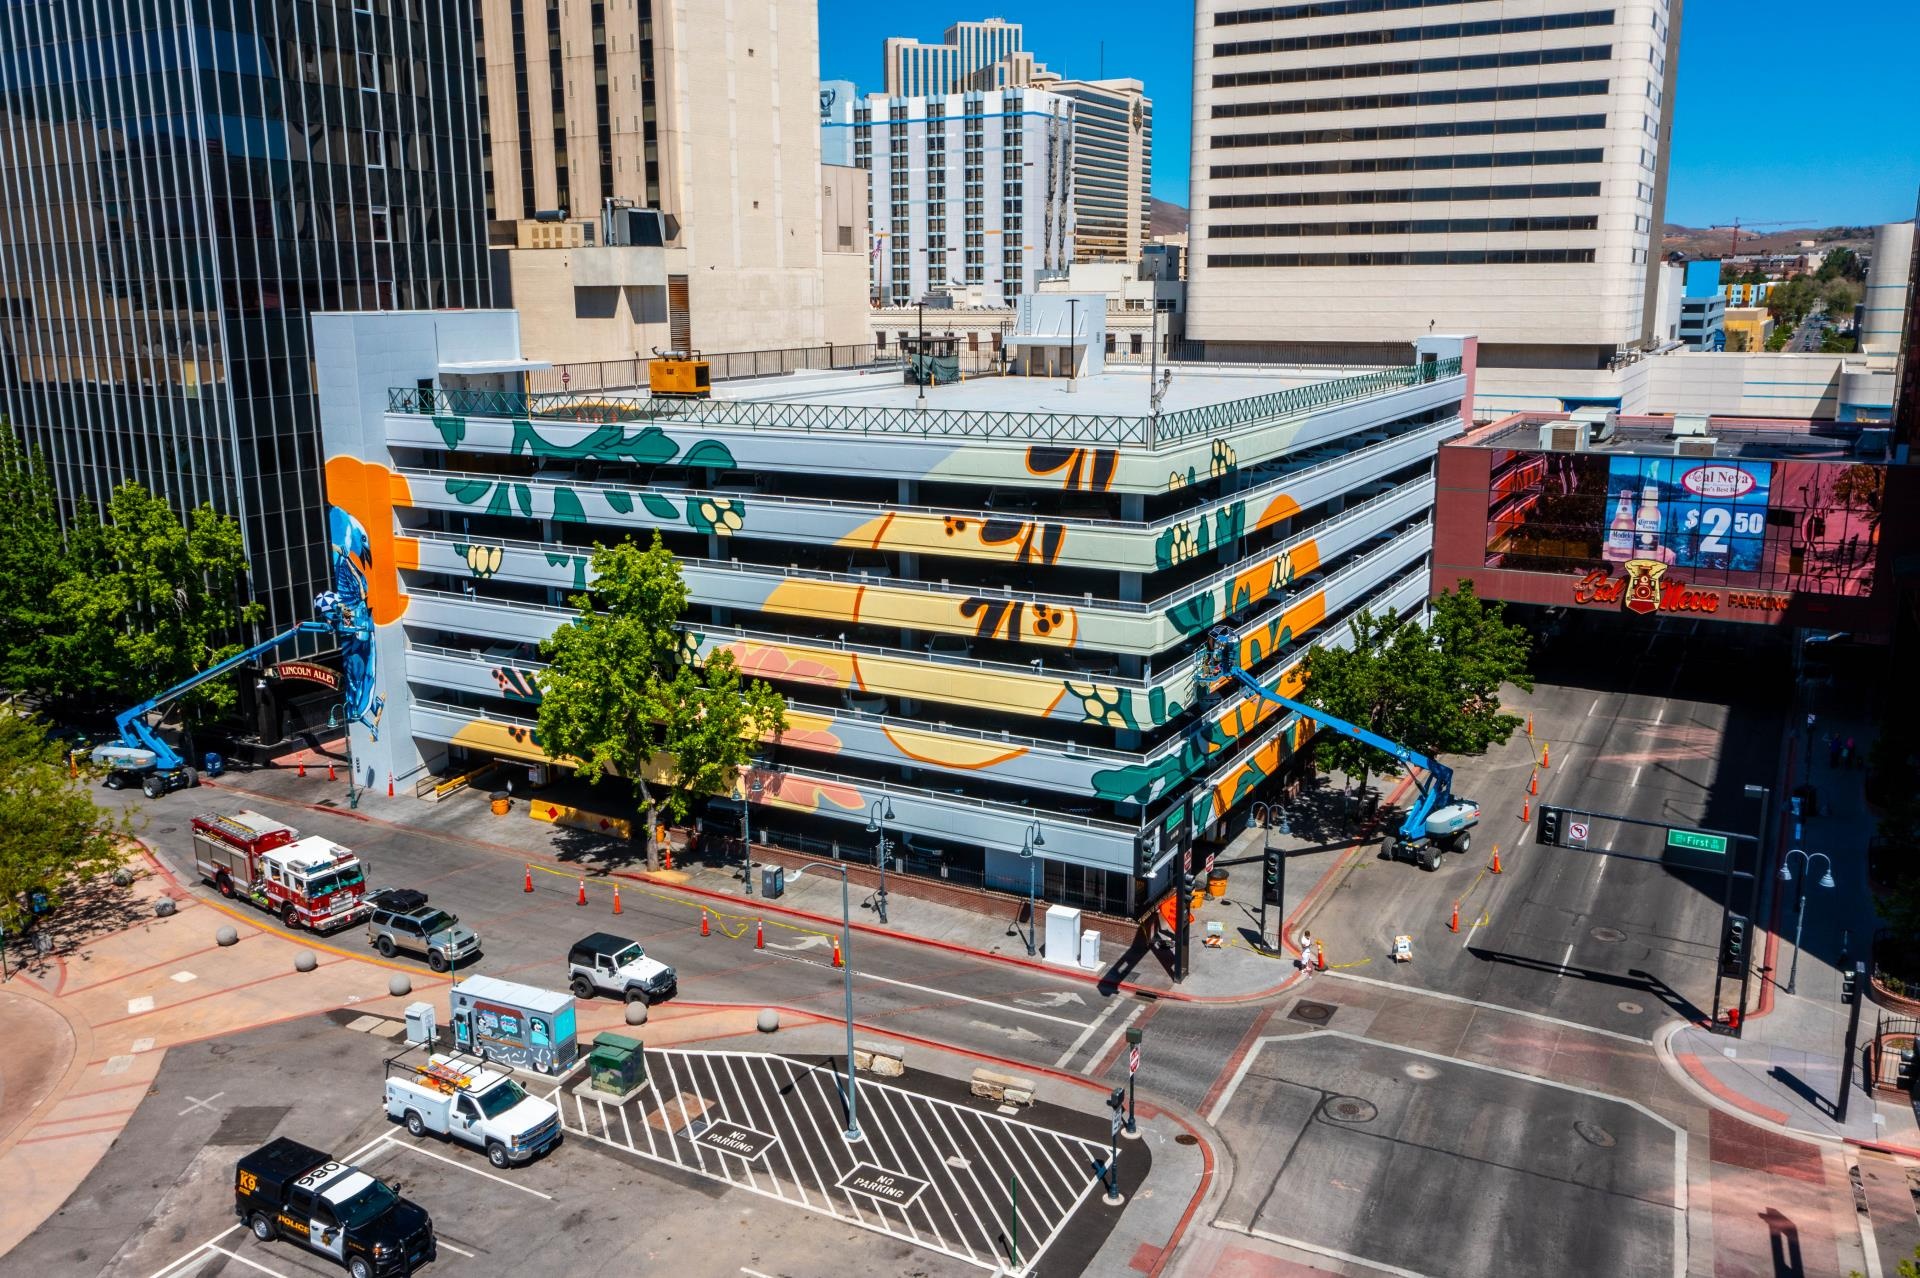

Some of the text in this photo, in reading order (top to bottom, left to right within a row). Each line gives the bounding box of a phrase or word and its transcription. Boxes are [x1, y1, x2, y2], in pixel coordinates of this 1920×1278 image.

[1694, 471, 1749, 484] Cal Neva
[1575, 571, 1789, 613] Cal Neva PARKING
[282, 666, 335, 684] LINCOLN ALLEY
[1687, 836, 1709, 847] First
[707, 1133, 754, 1152] PARKING
[729, 1131, 747, 1141] NO
[240, 1173, 256, 1191] K9
[853, 1177, 905, 1198] PARKING
[876, 1175, 895, 1186] NO
[278, 1215, 310, 1233] POLICE
